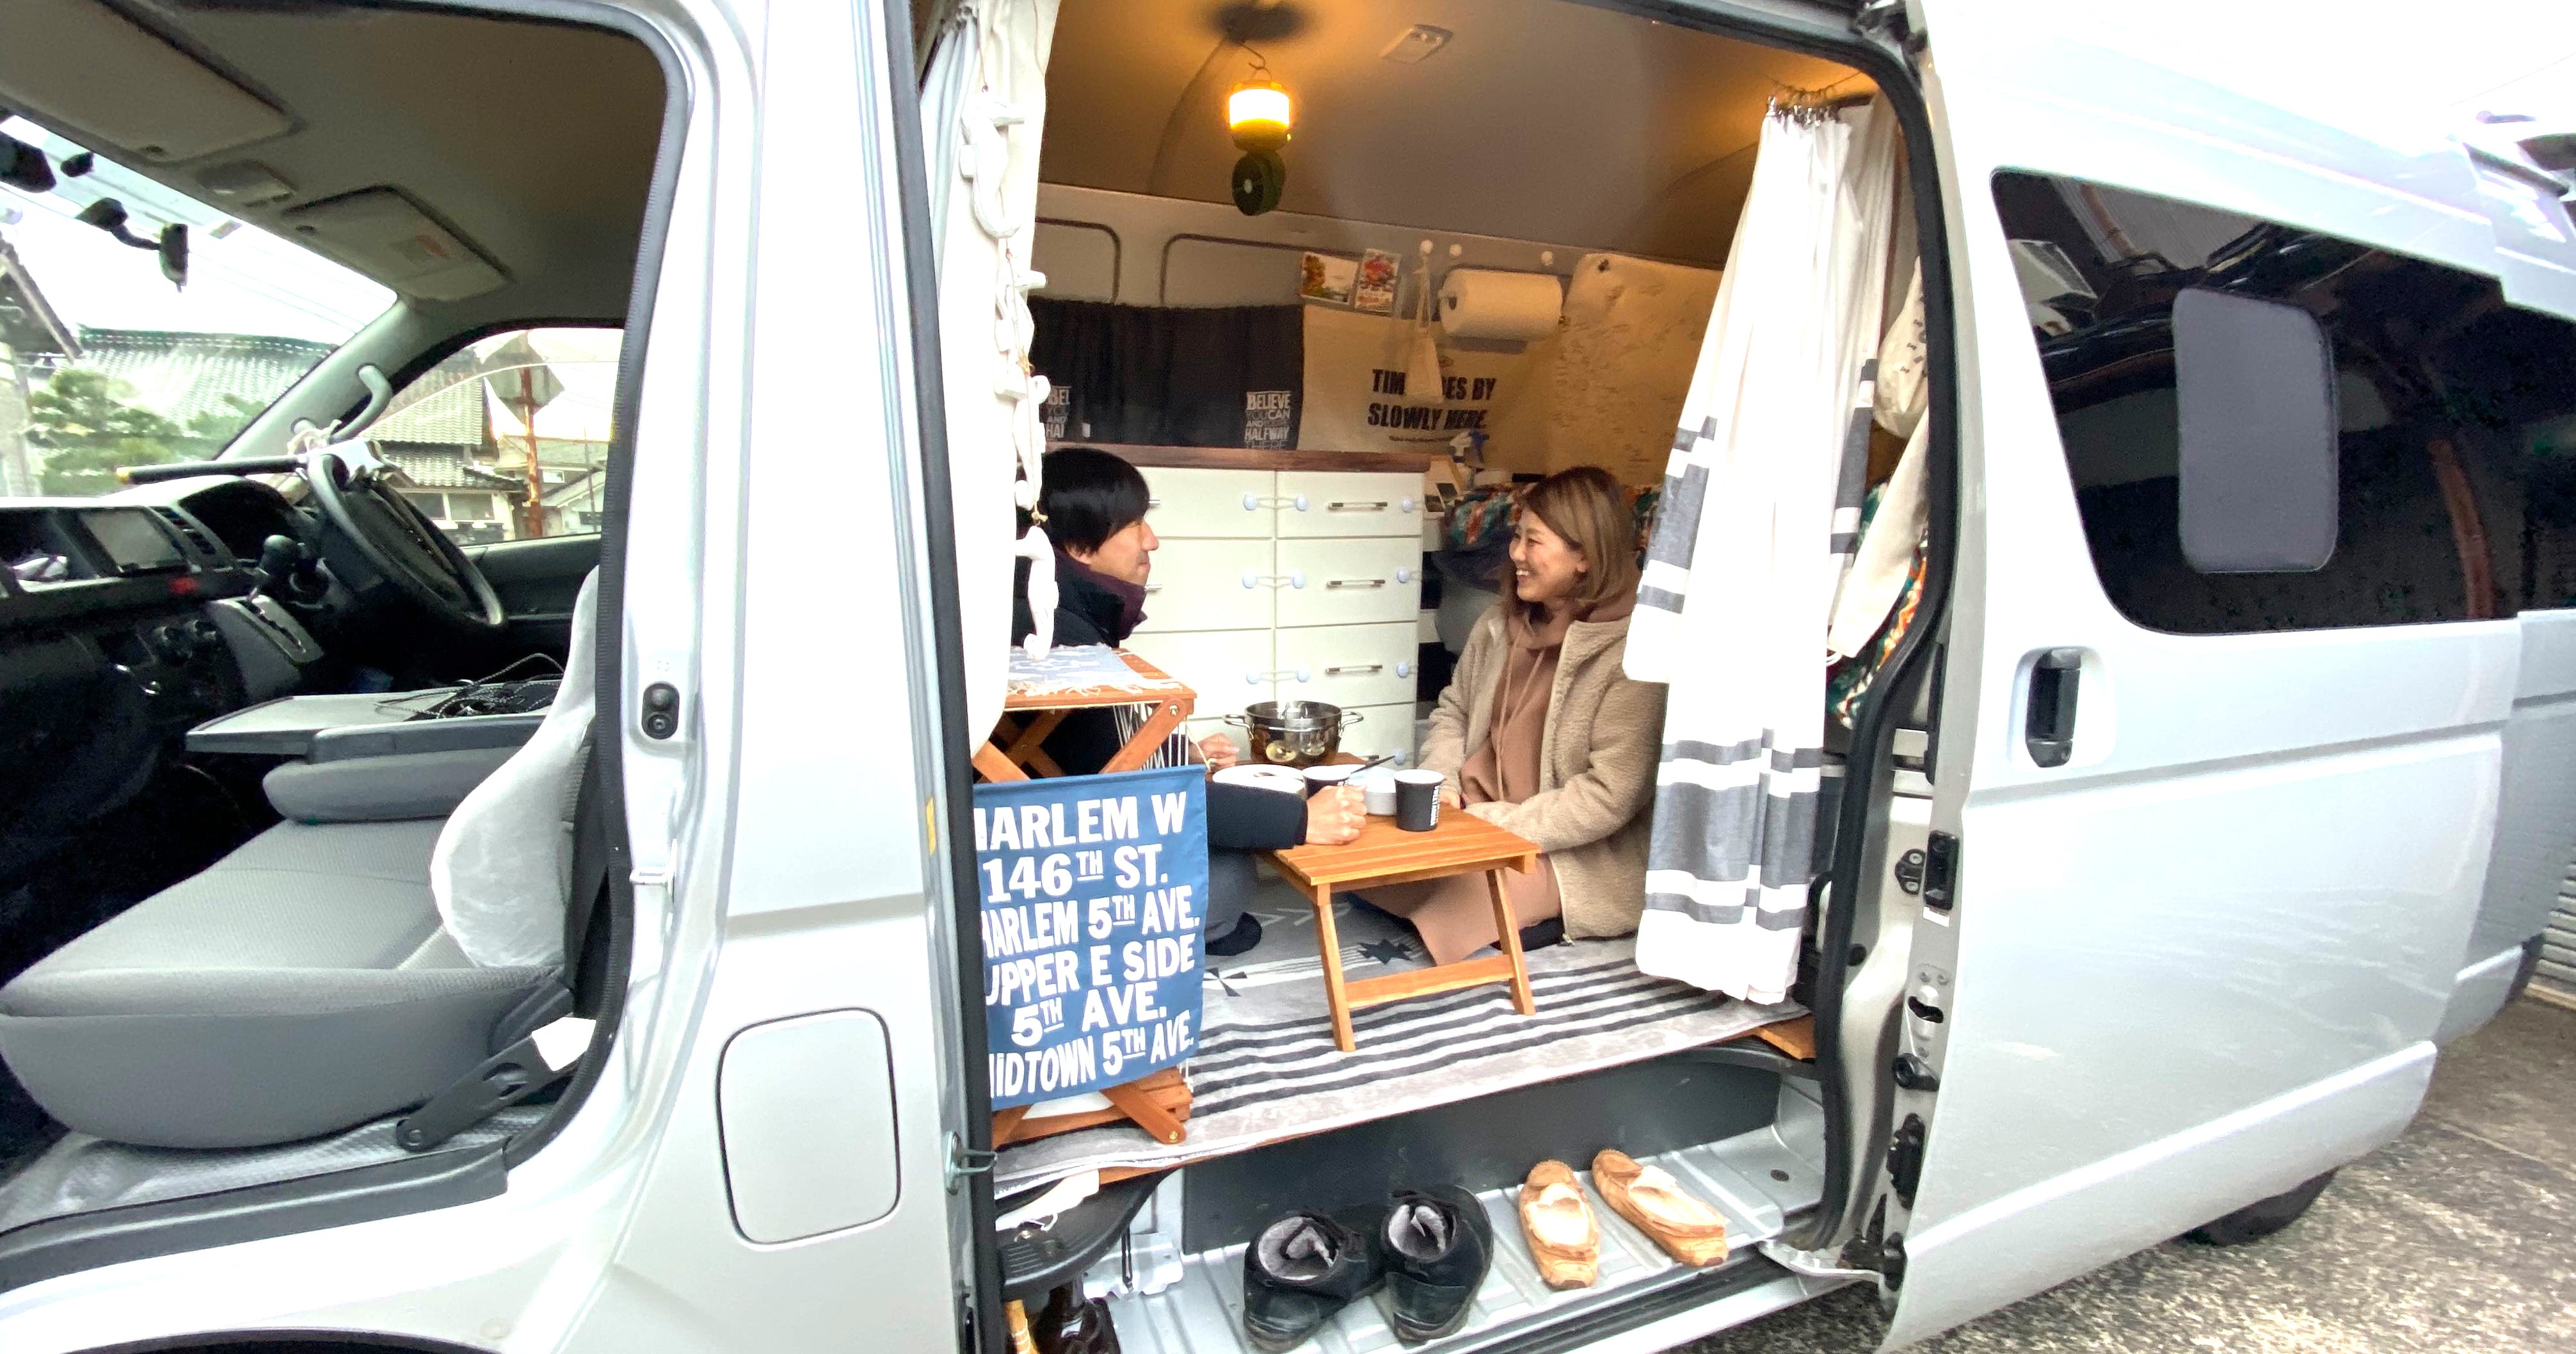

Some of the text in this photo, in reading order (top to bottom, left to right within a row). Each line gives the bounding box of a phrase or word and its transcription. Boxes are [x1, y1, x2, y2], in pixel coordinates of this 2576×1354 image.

[1246, 392, 1290, 410] BELIEVE
[1373, 369, 1405, 395] TIM
[1244, 427, 1290, 440] HALFWAY
[1268, 410, 1290, 419] CAN
[1368, 403, 1443, 430] SLOWLY
[1151, 791, 1187, 835] W
[983, 843, 1168, 903] 146TH ST.
[1088, 894, 1136, 939] 5TH
[1142, 885, 1200, 935] AVE.
[1090, 944, 1112, 986] E
[1123, 933, 1196, 981] SIDE
[1011, 981, 1167, 1047] 5TH AVE.
[989, 1010, 1194, 1099] IDTOWN 5TH AVE.
